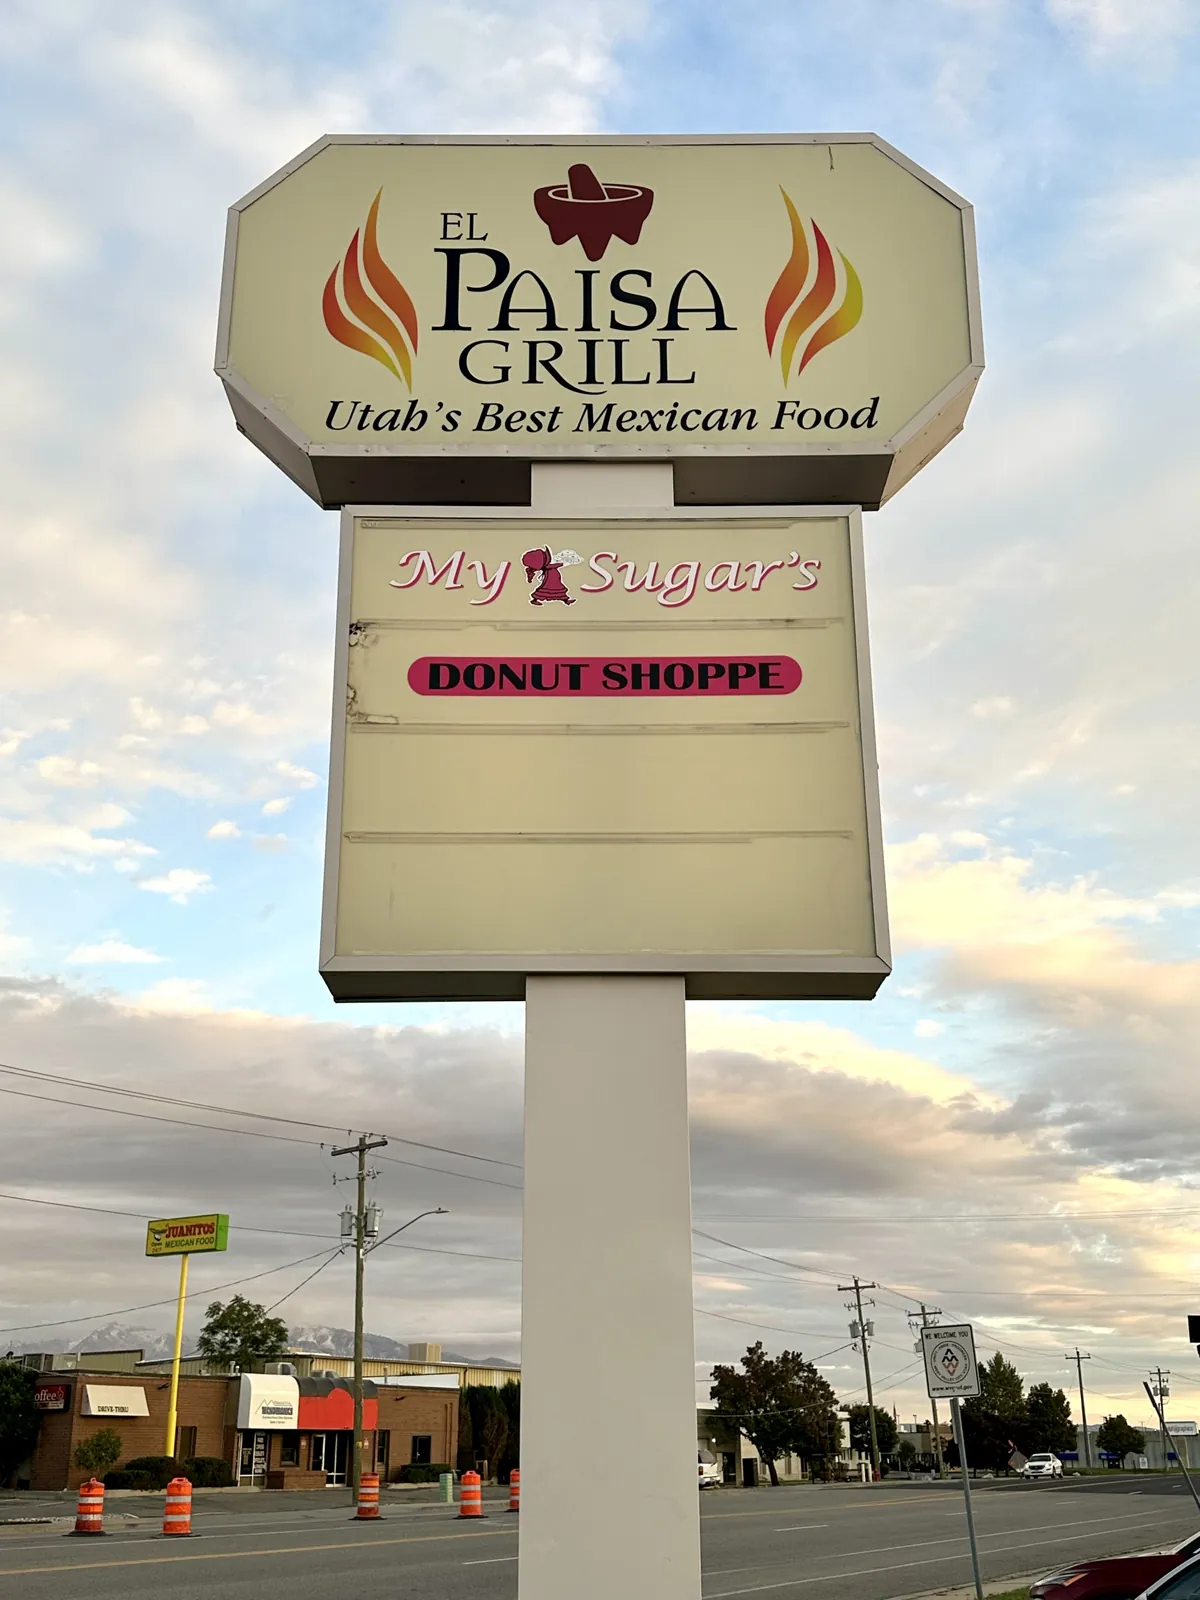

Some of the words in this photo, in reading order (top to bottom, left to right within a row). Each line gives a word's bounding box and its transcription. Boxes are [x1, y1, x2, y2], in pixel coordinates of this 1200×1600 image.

[439, 212, 489, 242] EL
[431, 247, 738, 332] PAISA
[458, 338, 696, 396] GRILL
[325, 398, 462, 433] Utah's
[472, 401, 564, 433] Best
[571, 400, 759, 433] Mexican
[770, 396, 880, 430] Food
[388, 549, 511, 606] My
[579, 550, 821, 608] Sugar's
[428, 662, 590, 691] DONUT
[601, 661, 785, 691] SHOPPE
[165, 1223, 215, 1238] JUANITOS
[165, 1239, 194, 1248] MEXICAN
[195, 1237, 215, 1245] FOOD
[934, 1331, 956, 1339] WELCOME
[34, 1389, 57, 1401] offee
